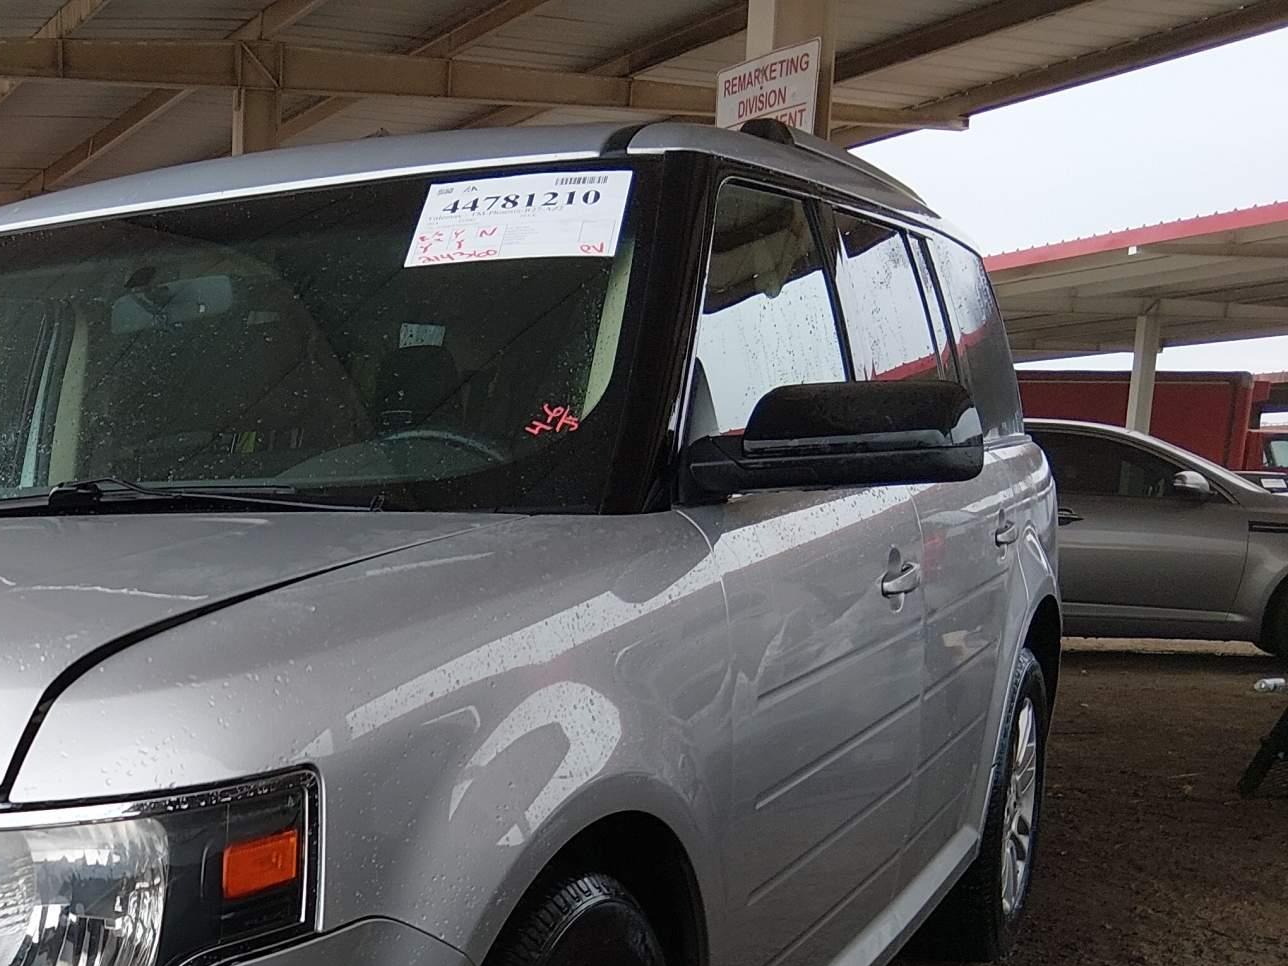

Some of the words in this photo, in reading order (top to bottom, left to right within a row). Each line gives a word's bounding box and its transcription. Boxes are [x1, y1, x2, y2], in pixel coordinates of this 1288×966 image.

[723, 53, 810, 97] REMARKETING
[738, 86, 787, 119] DIVISION
[442, 188, 601, 214] 44781210
